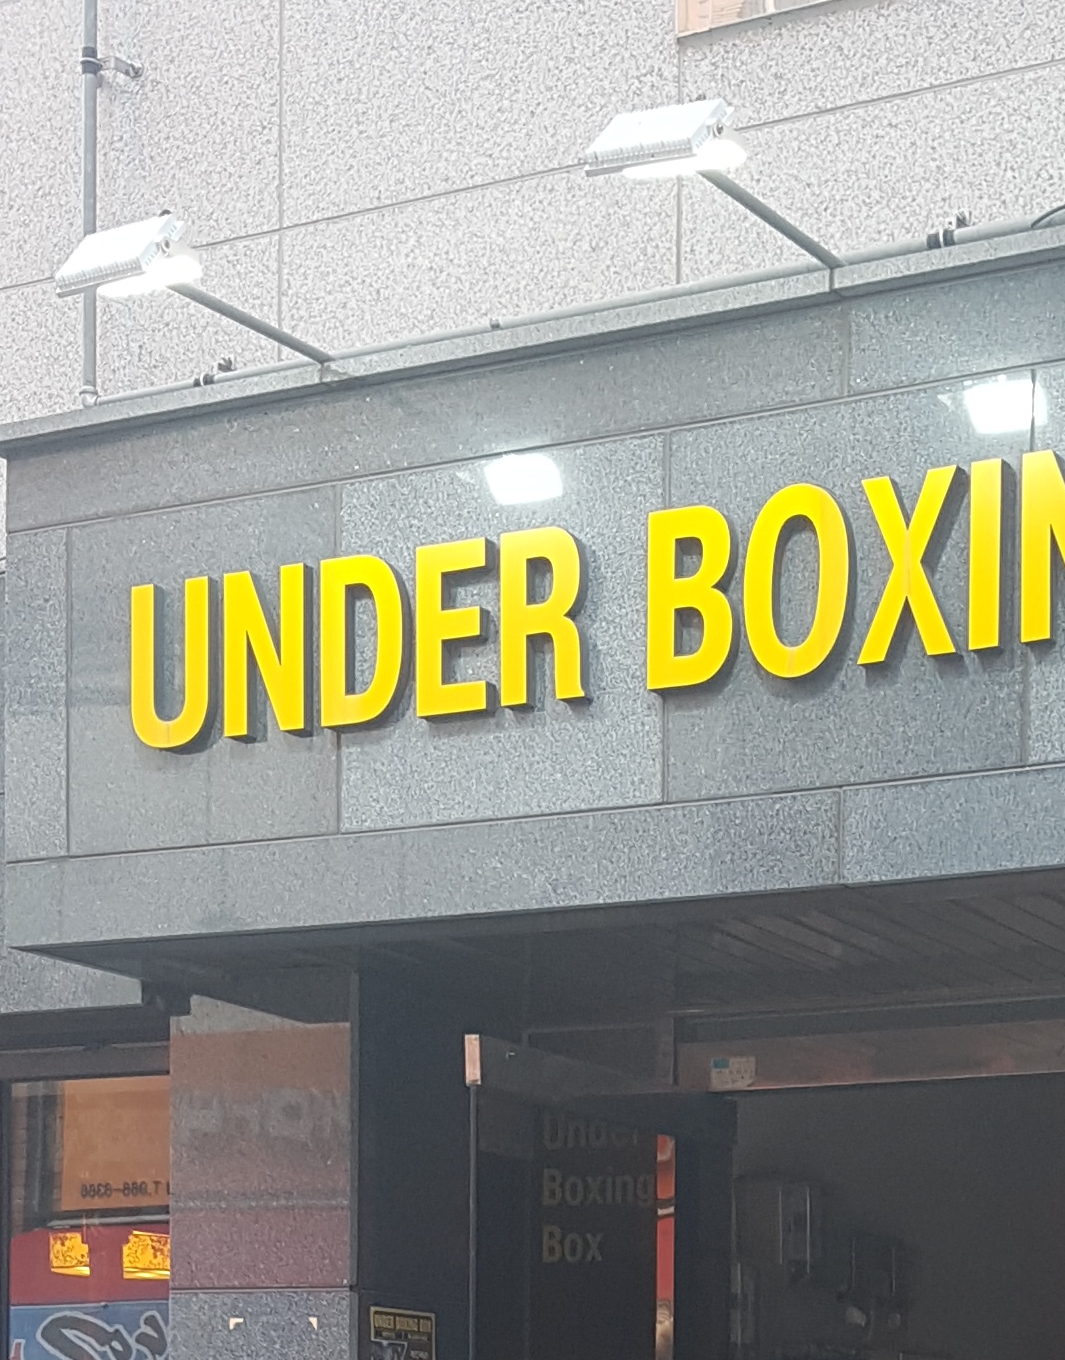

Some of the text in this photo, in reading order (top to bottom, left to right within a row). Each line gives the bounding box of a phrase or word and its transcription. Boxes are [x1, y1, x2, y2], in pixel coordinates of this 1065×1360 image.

[131, 526, 588, 749] UNDER
[542, 1166, 655, 1208] Boxing
[542, 1225, 605, 1264] Box
